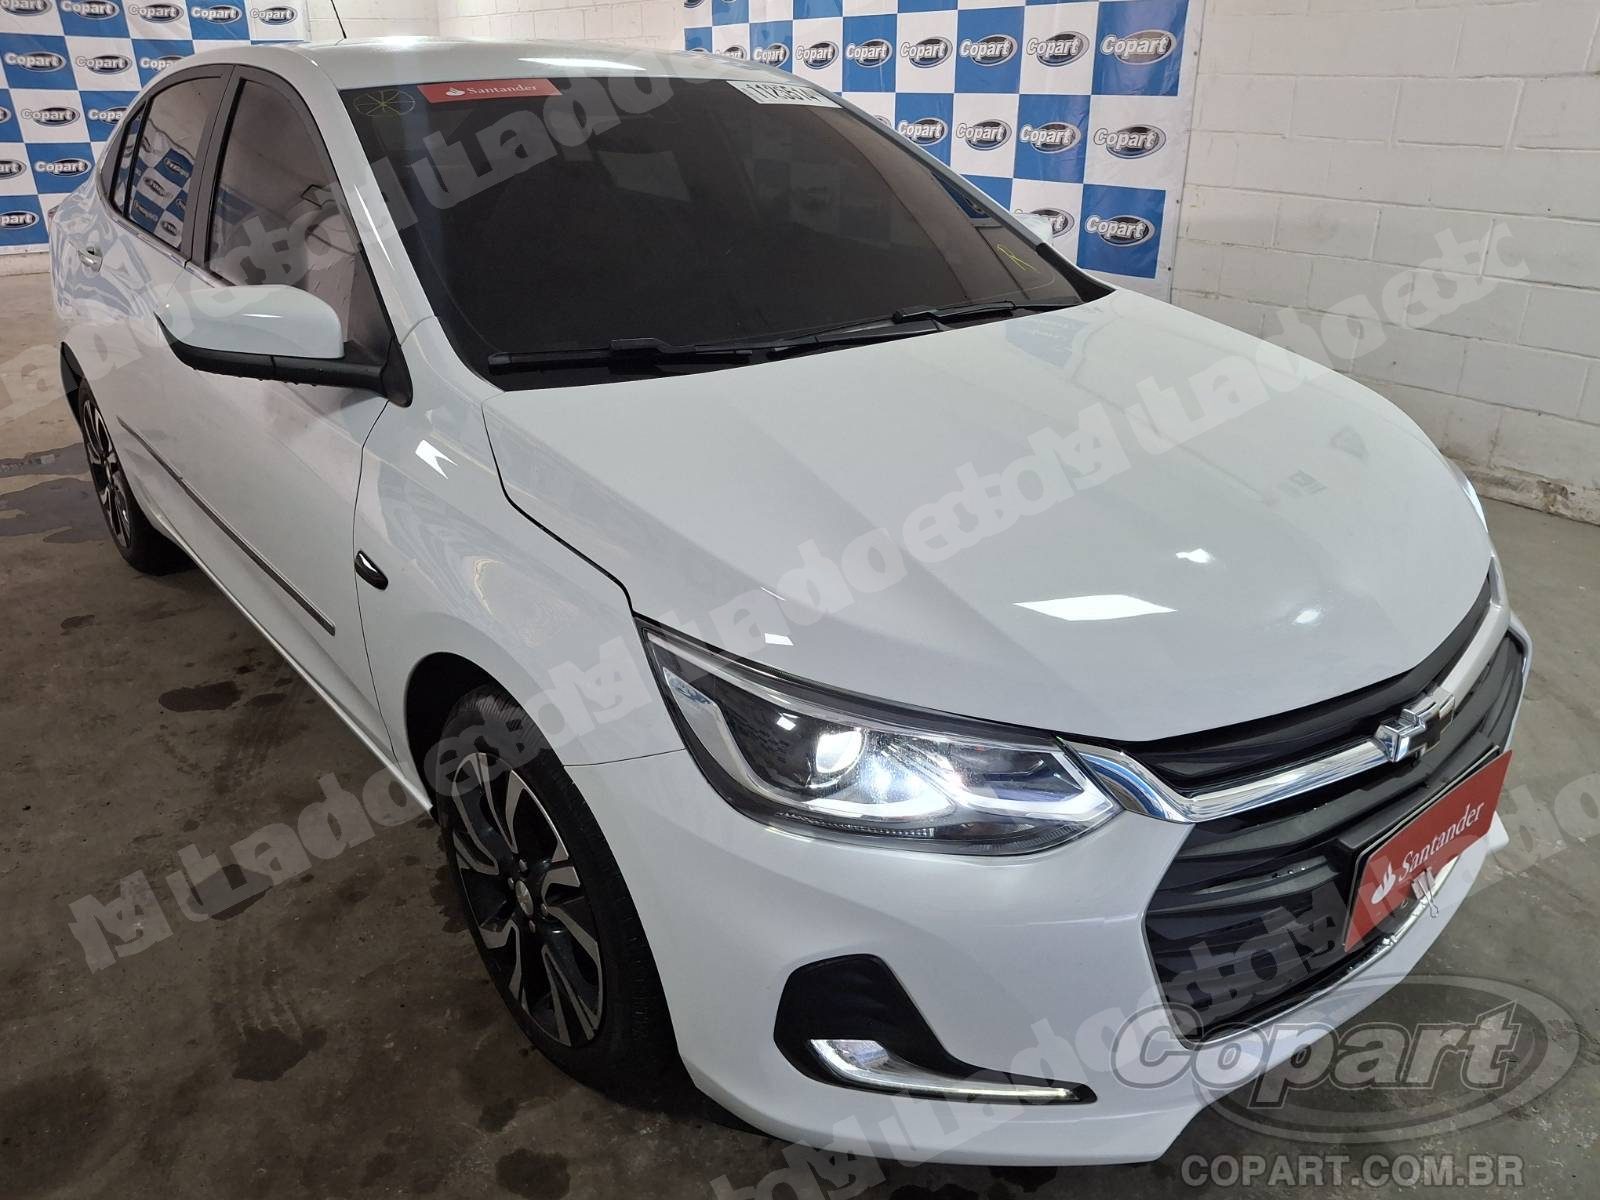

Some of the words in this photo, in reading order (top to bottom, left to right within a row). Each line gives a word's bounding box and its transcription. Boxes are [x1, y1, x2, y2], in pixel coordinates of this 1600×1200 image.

[0, 0, 44, 13] opart
[61, 0, 113, 15] Copart
[129, 3, 177, 19] Copart
[191, 6, 236, 20] Copart
[250, 7, 292, 21] Copart
[753, 46, 784, 63] Copart
[796, 45, 832, 62] Copart
[846, 42, 887, 63] Copart
[900, 42, 946, 63] Copart
[960, 39, 1013, 60] Copart
[1026, 36, 1080, 60] Copart
[1101, 34, 1171, 60] Copart
[4, 52, 60, 69] Copart
[76, 55, 124, 70] Copart
[140, 57, 174, 71] Copa
[467, 84, 537, 96] Santander
[21, 108, 73, 123] Copart
[88, 108, 123, 123] Copa
[898, 120, 946, 141] Copart
[956, 122, 1006, 144] Copart
[1020, 124, 1075, 145] Copart
[1094, 127, 1160, 150] Copart
[35, 160, 84, 175] Copart
[0, 209, 34, 226] part
[1085, 214, 1147, 240] Copart
[1398, 801, 1485, 883] Santander
